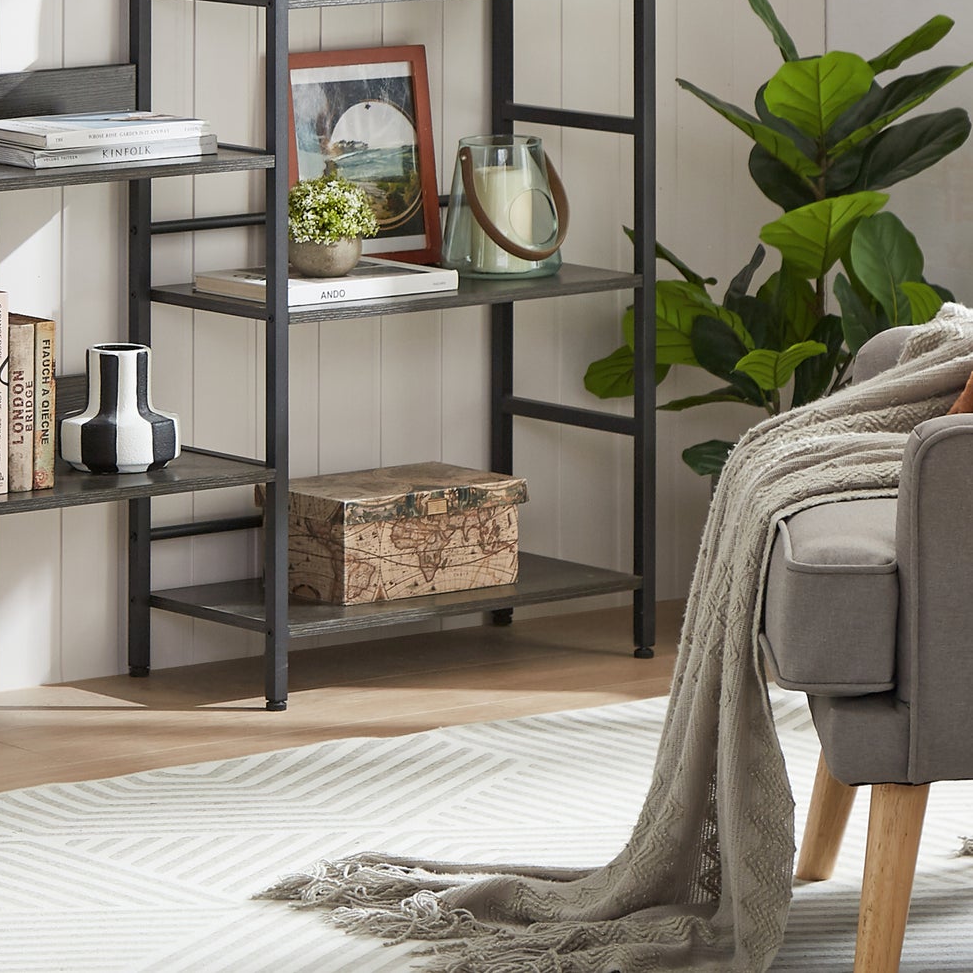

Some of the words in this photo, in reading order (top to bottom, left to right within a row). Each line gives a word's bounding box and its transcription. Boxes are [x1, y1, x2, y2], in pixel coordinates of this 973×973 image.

[102, 145, 152, 158] KINFOLK
[320, 289, 346, 300] ANDO
[41, 388, 51, 397] A
[12, 370, 24, 445] LONDON
[25, 381, 33, 432] BRIDGE
